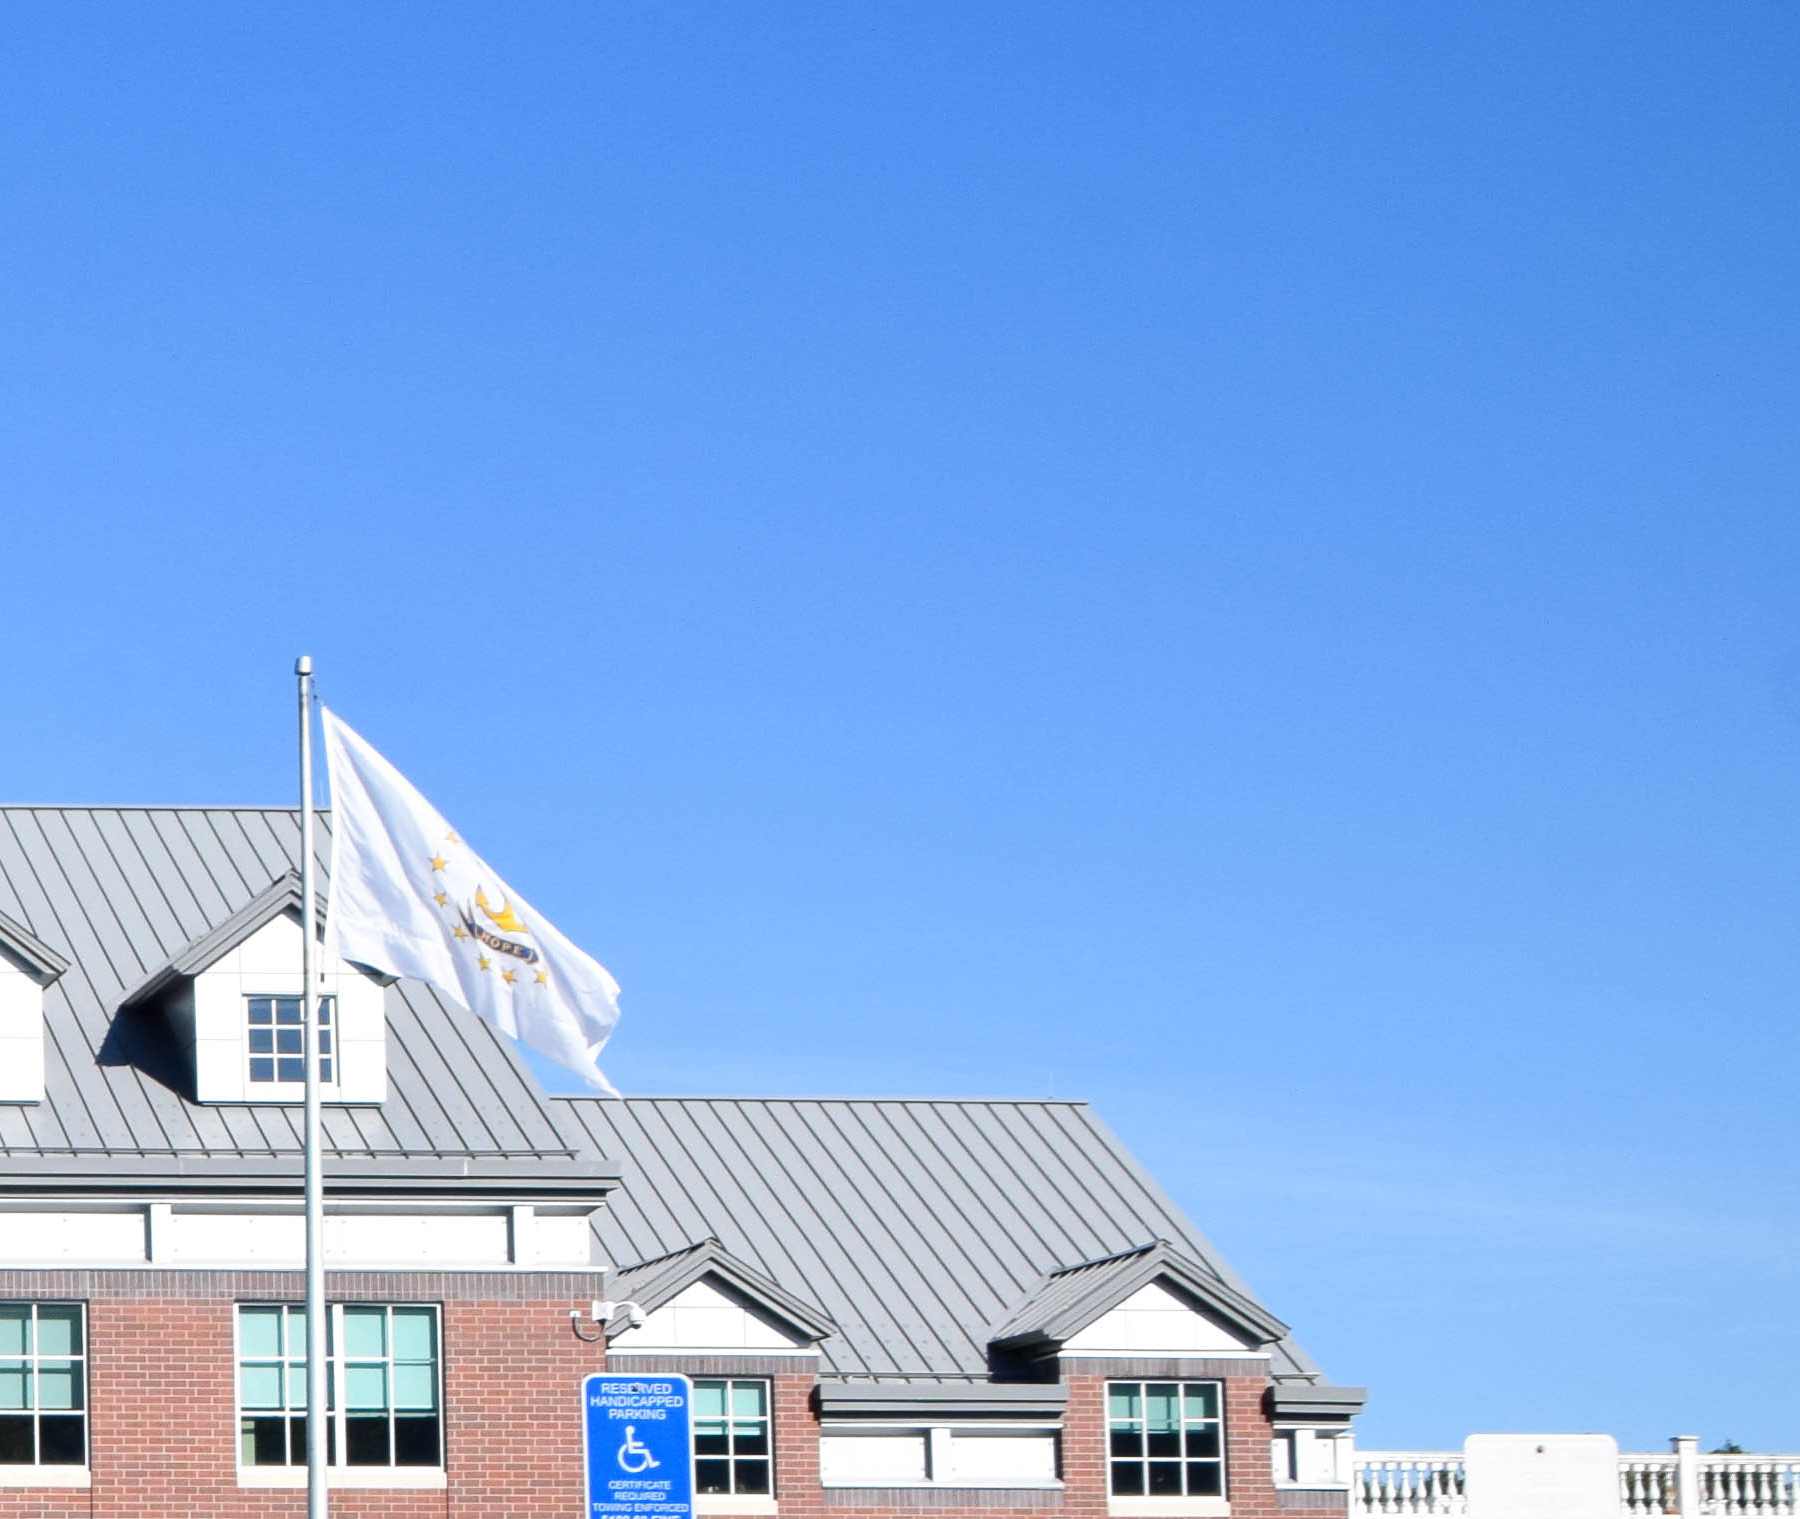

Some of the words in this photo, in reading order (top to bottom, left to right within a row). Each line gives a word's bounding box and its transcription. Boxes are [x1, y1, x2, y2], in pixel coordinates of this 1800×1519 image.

[480, 932, 520, 956] HOPE
[601, 1383, 672, 1394] RESERVED
[591, 1397, 684, 1407] HANDICAPPED
[609, 1409, 667, 1420] PARKING
[609, 1481, 671, 1489] CERTIFICATE
[615, 1491, 666, 1500] REQUIRED
[593, 1503, 632, 1512] TOWING
[635, 1503, 689, 1512] ENFORCED
